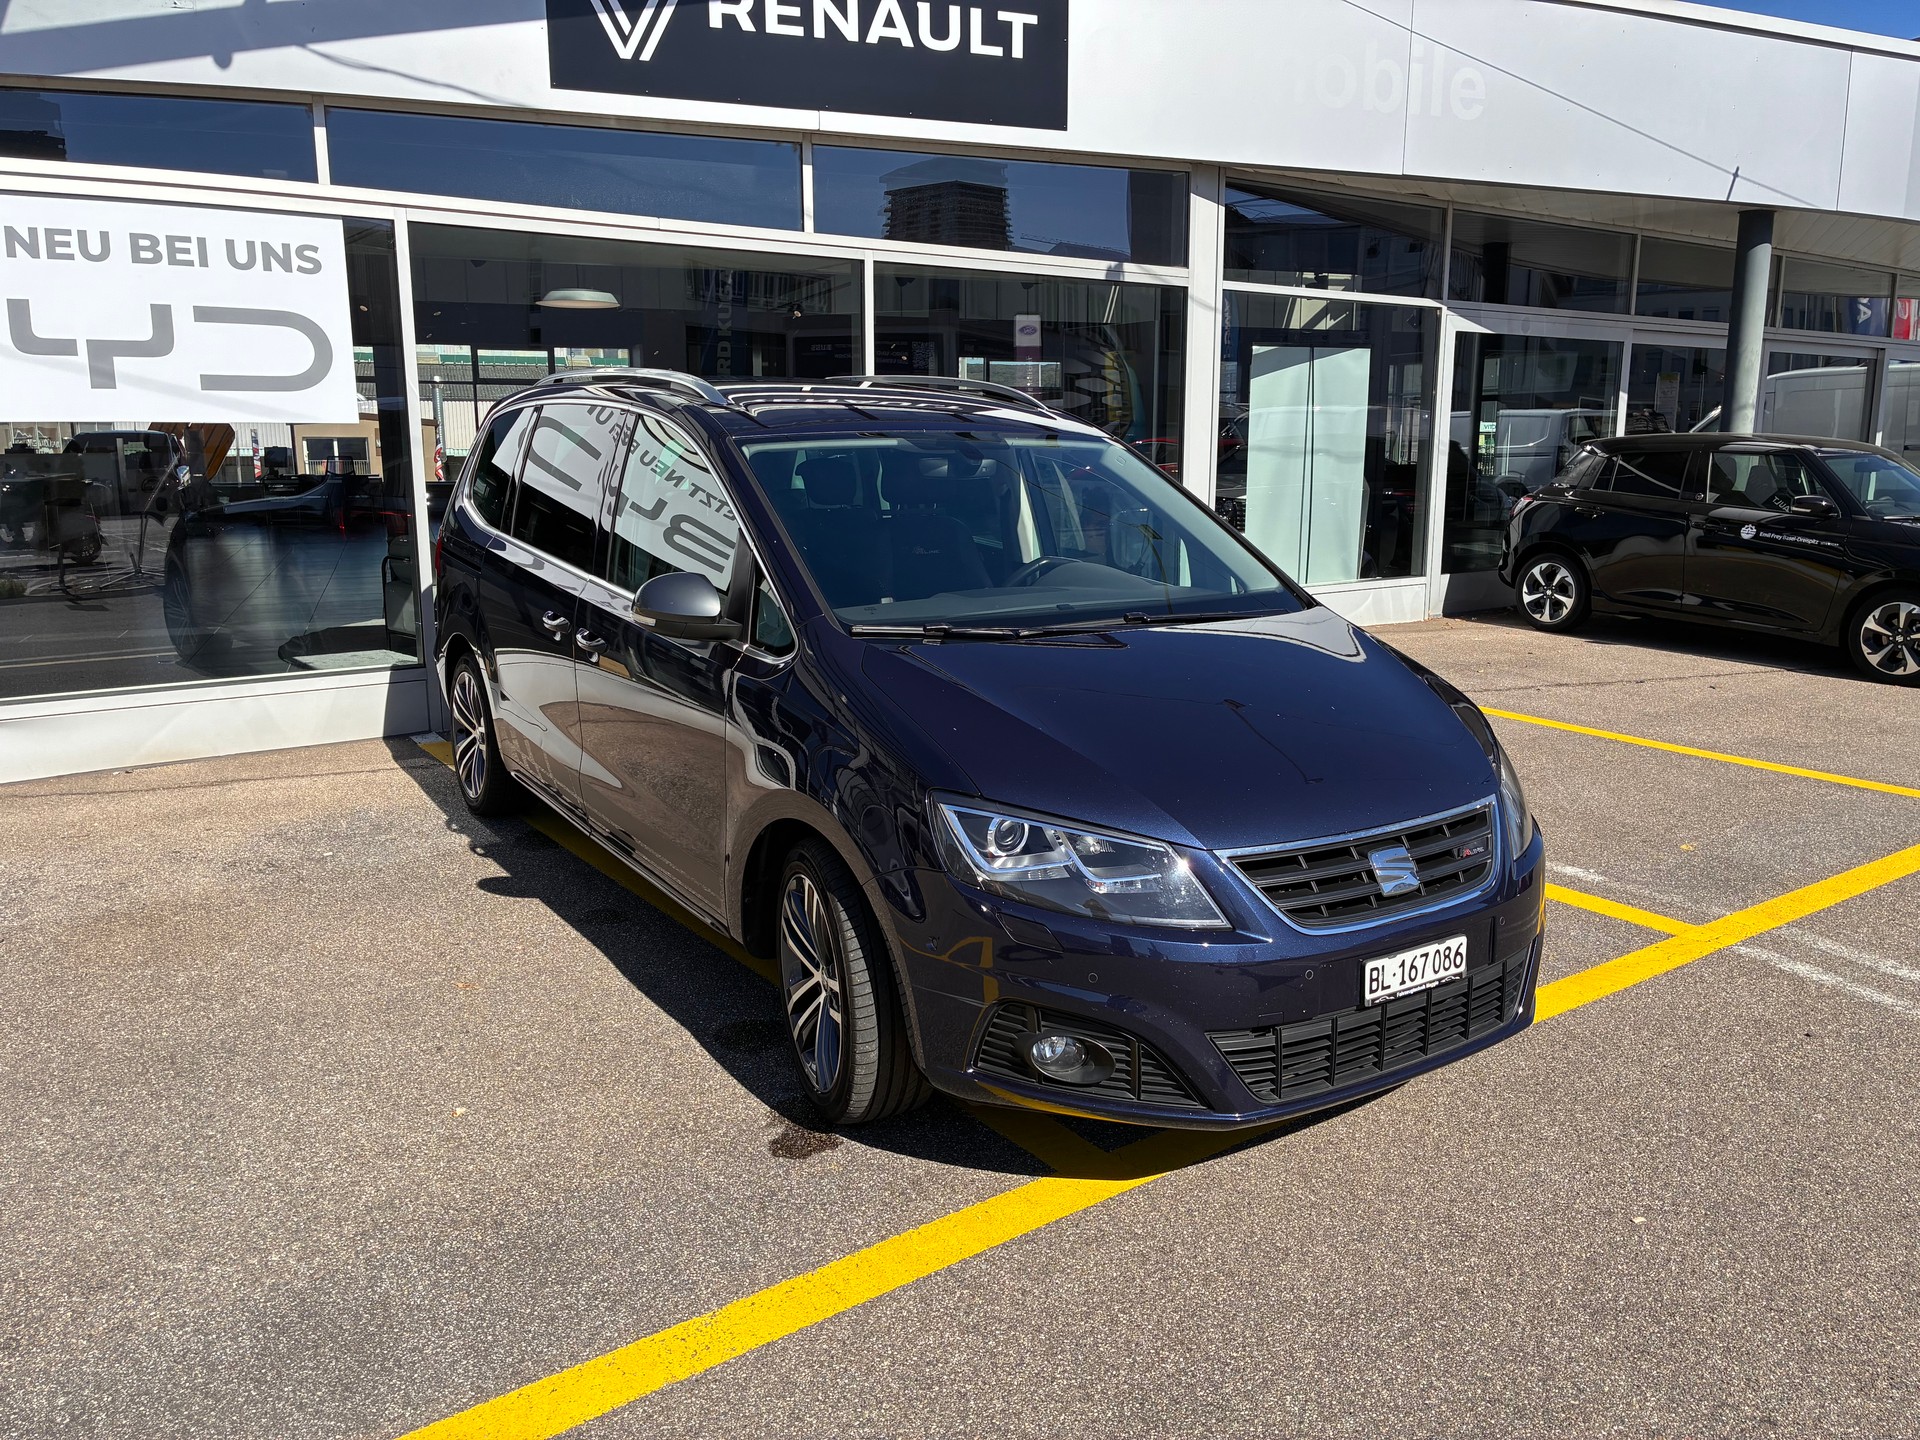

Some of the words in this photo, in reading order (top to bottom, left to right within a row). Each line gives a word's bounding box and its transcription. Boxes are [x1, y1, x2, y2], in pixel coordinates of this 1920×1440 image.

[709, 0, 1038, 58] RENAULT
[1296, 40, 1486, 121] obile
[4, 225, 111, 263] NEU
[129, 232, 209, 268] BEI
[225, 238, 323, 275] UNS
[1771, 533, 1783, 541] Frey
